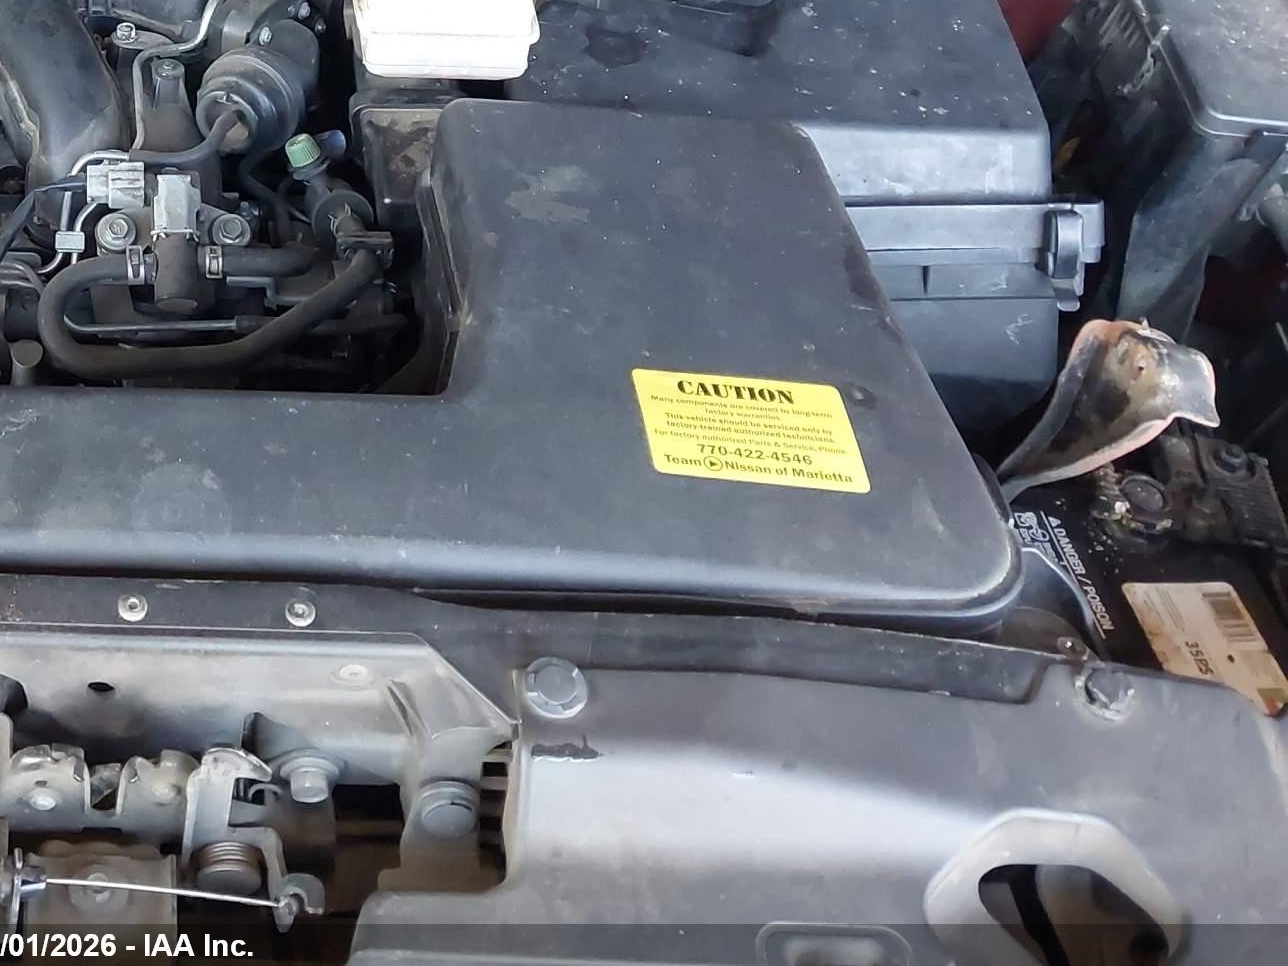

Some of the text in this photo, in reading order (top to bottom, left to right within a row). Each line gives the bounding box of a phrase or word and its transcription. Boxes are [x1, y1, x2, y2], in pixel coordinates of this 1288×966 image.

[677, 380, 795, 404] CAUTION
[696, 444, 813, 466] 770-422-4546
[664, 454, 853, 483] Team Nissan of Marietta
[1054, 528, 1087, 575] DANGER
[1082, 585, 1115, 631] POISON
